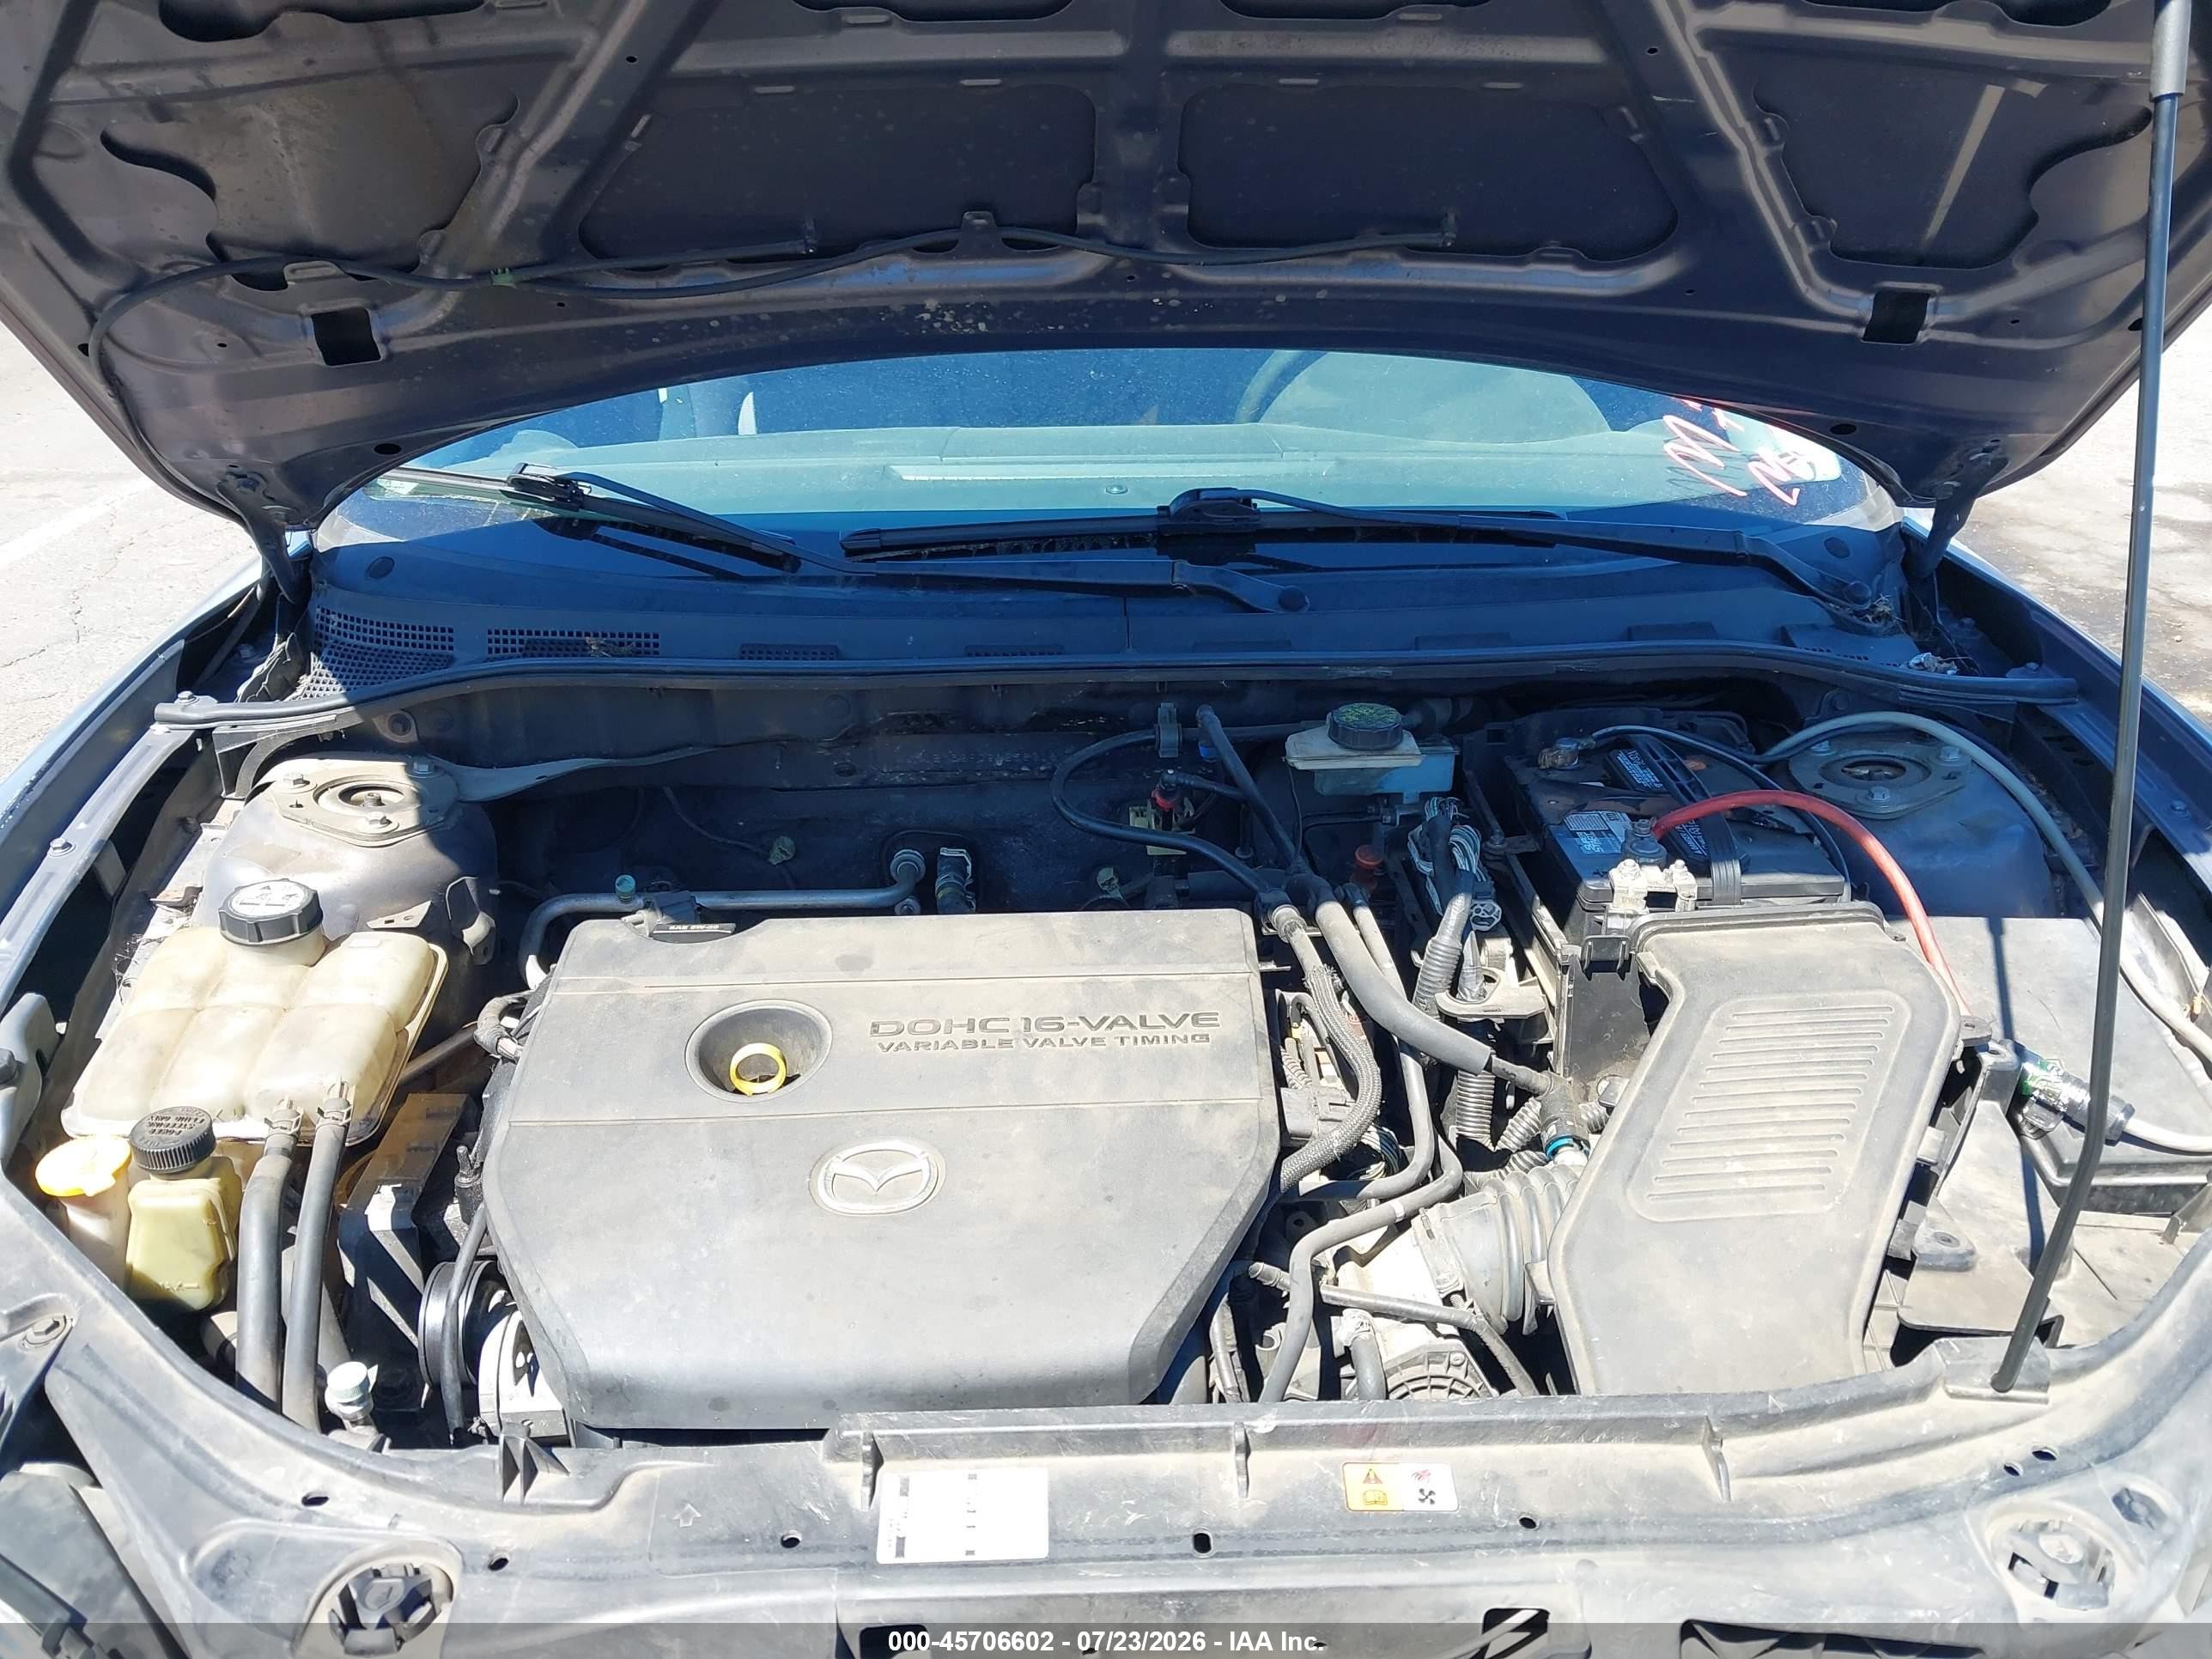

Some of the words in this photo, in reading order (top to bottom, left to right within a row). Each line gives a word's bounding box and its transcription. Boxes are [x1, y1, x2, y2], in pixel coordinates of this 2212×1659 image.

[870, 1017, 1011, 1037] DOHC
[1021, 1012, 1220, 1032] 16-VALVE
[878, 1039, 1013, 1053] VARIABLE
[1023, 1036, 1107, 1048] VALVE
[1114, 1033, 1211, 1046] TIMING
